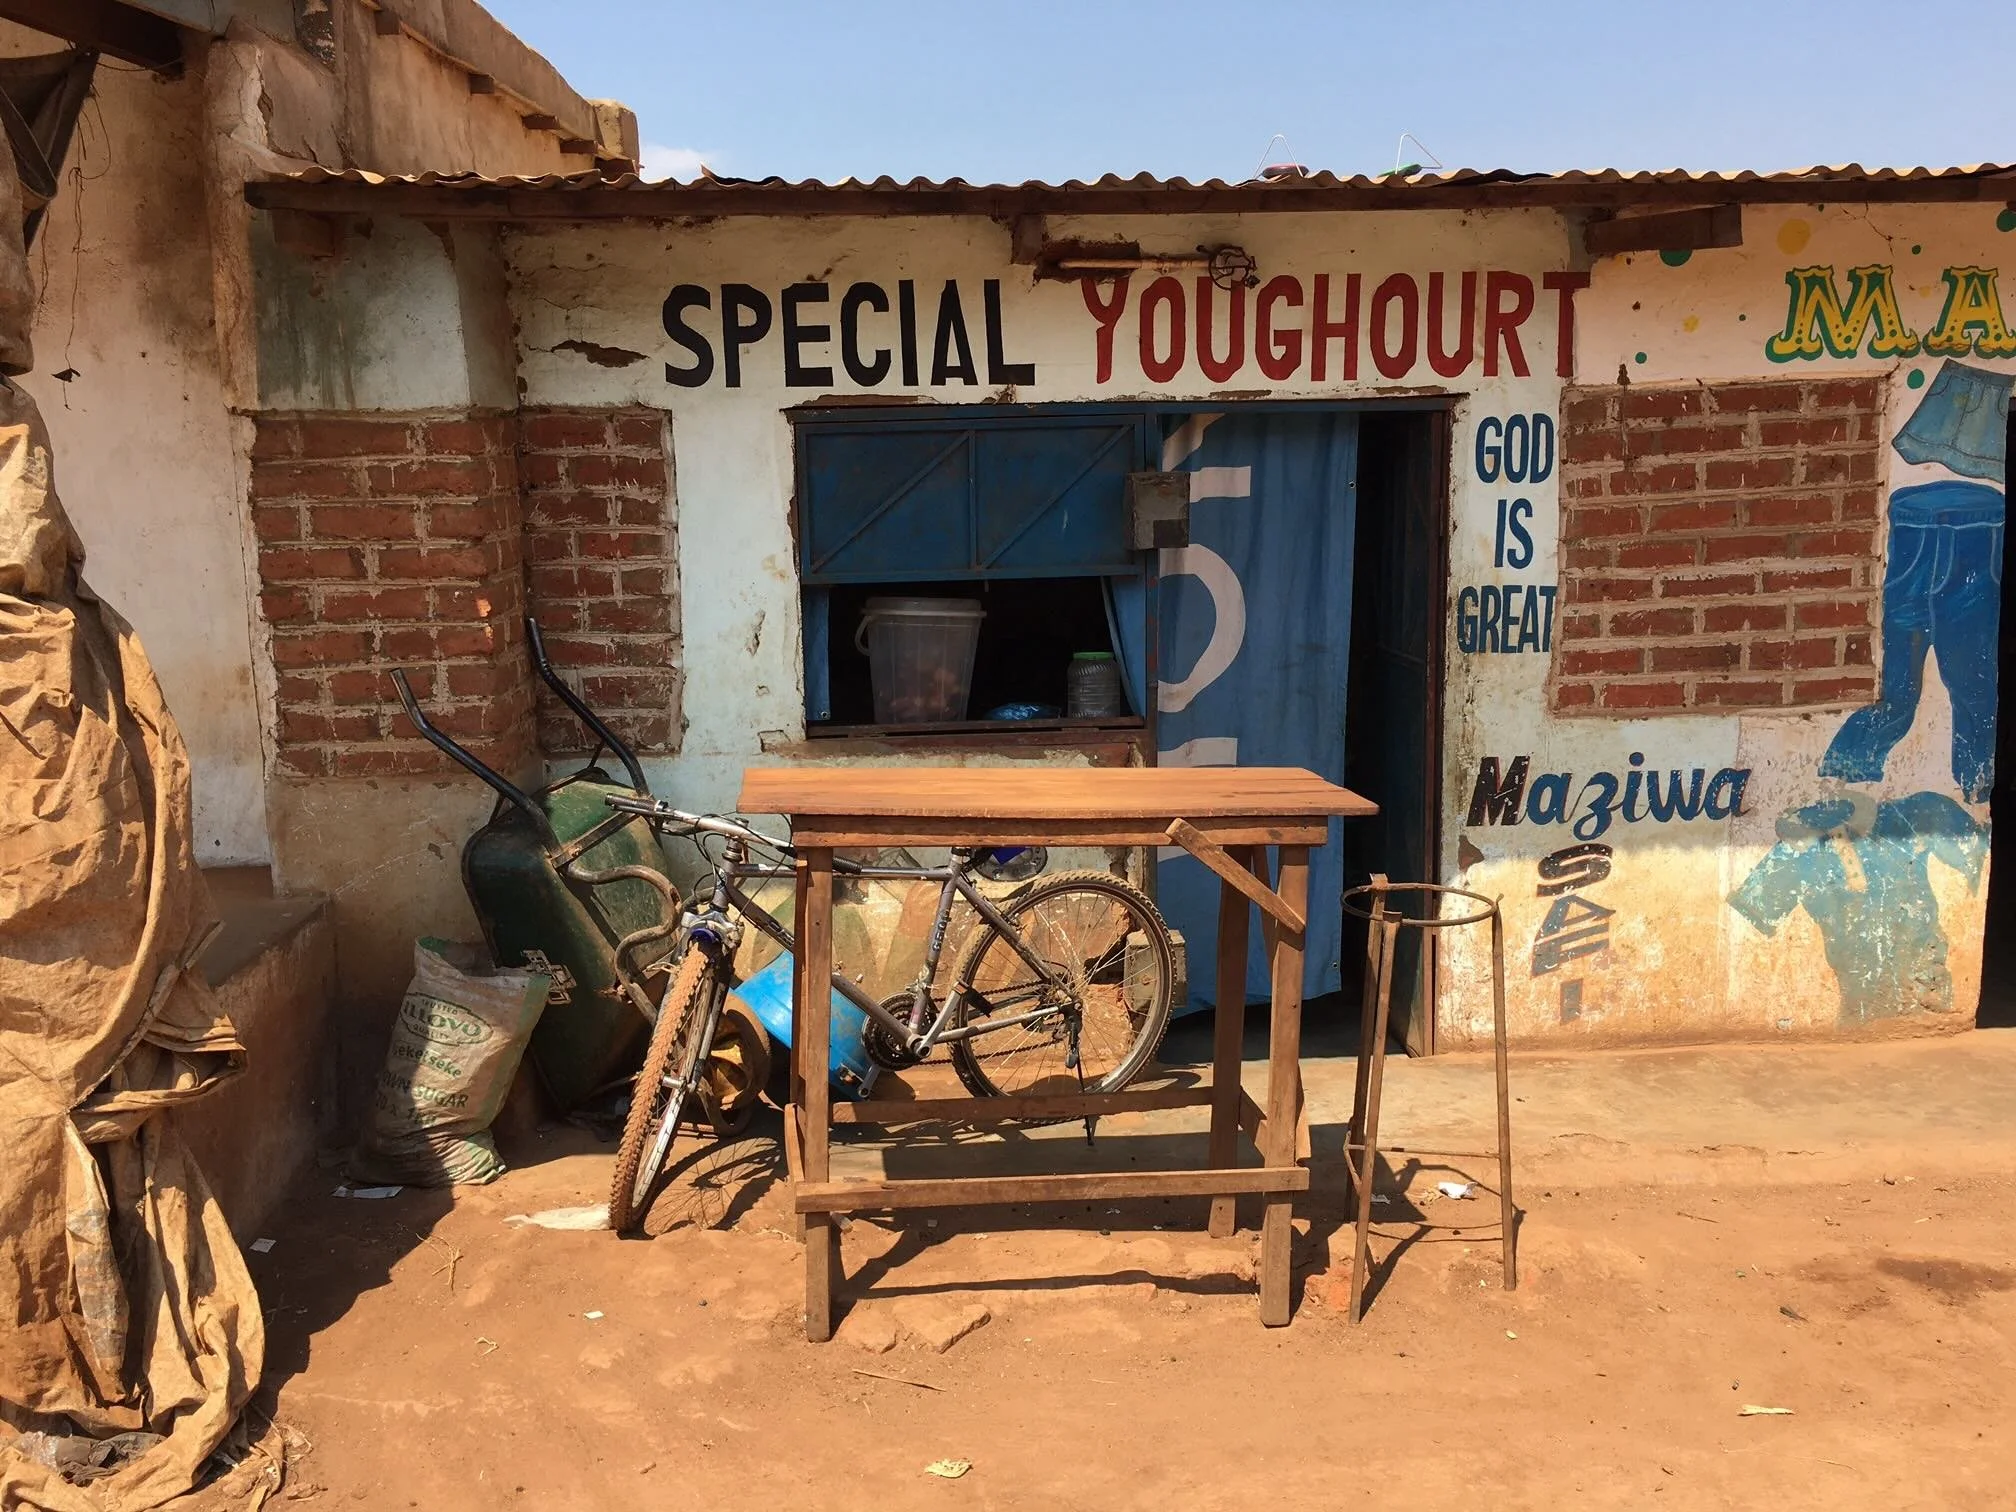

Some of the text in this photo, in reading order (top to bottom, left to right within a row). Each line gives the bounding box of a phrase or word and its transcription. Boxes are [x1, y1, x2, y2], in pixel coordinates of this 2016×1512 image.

[662, 271, 1591, 388] SPECIAL YOUGHOURT
[1765, 264, 2016, 364] MA
[1475, 413, 1554, 484] GOD
[1494, 497, 1534, 569] IS
[1456, 584, 1558, 654] GREAT
[1466, 752, 1757, 841] Maziwa
[1530, 843, 1616, 1026] SAFI
[402, 1000, 482, 1037] ILLOVO
[413, 1023, 449, 1040] QUALITY
[422, 999, 458, 1015] TRUSTED
[412, 1083, 469, 1108] SUGAR
